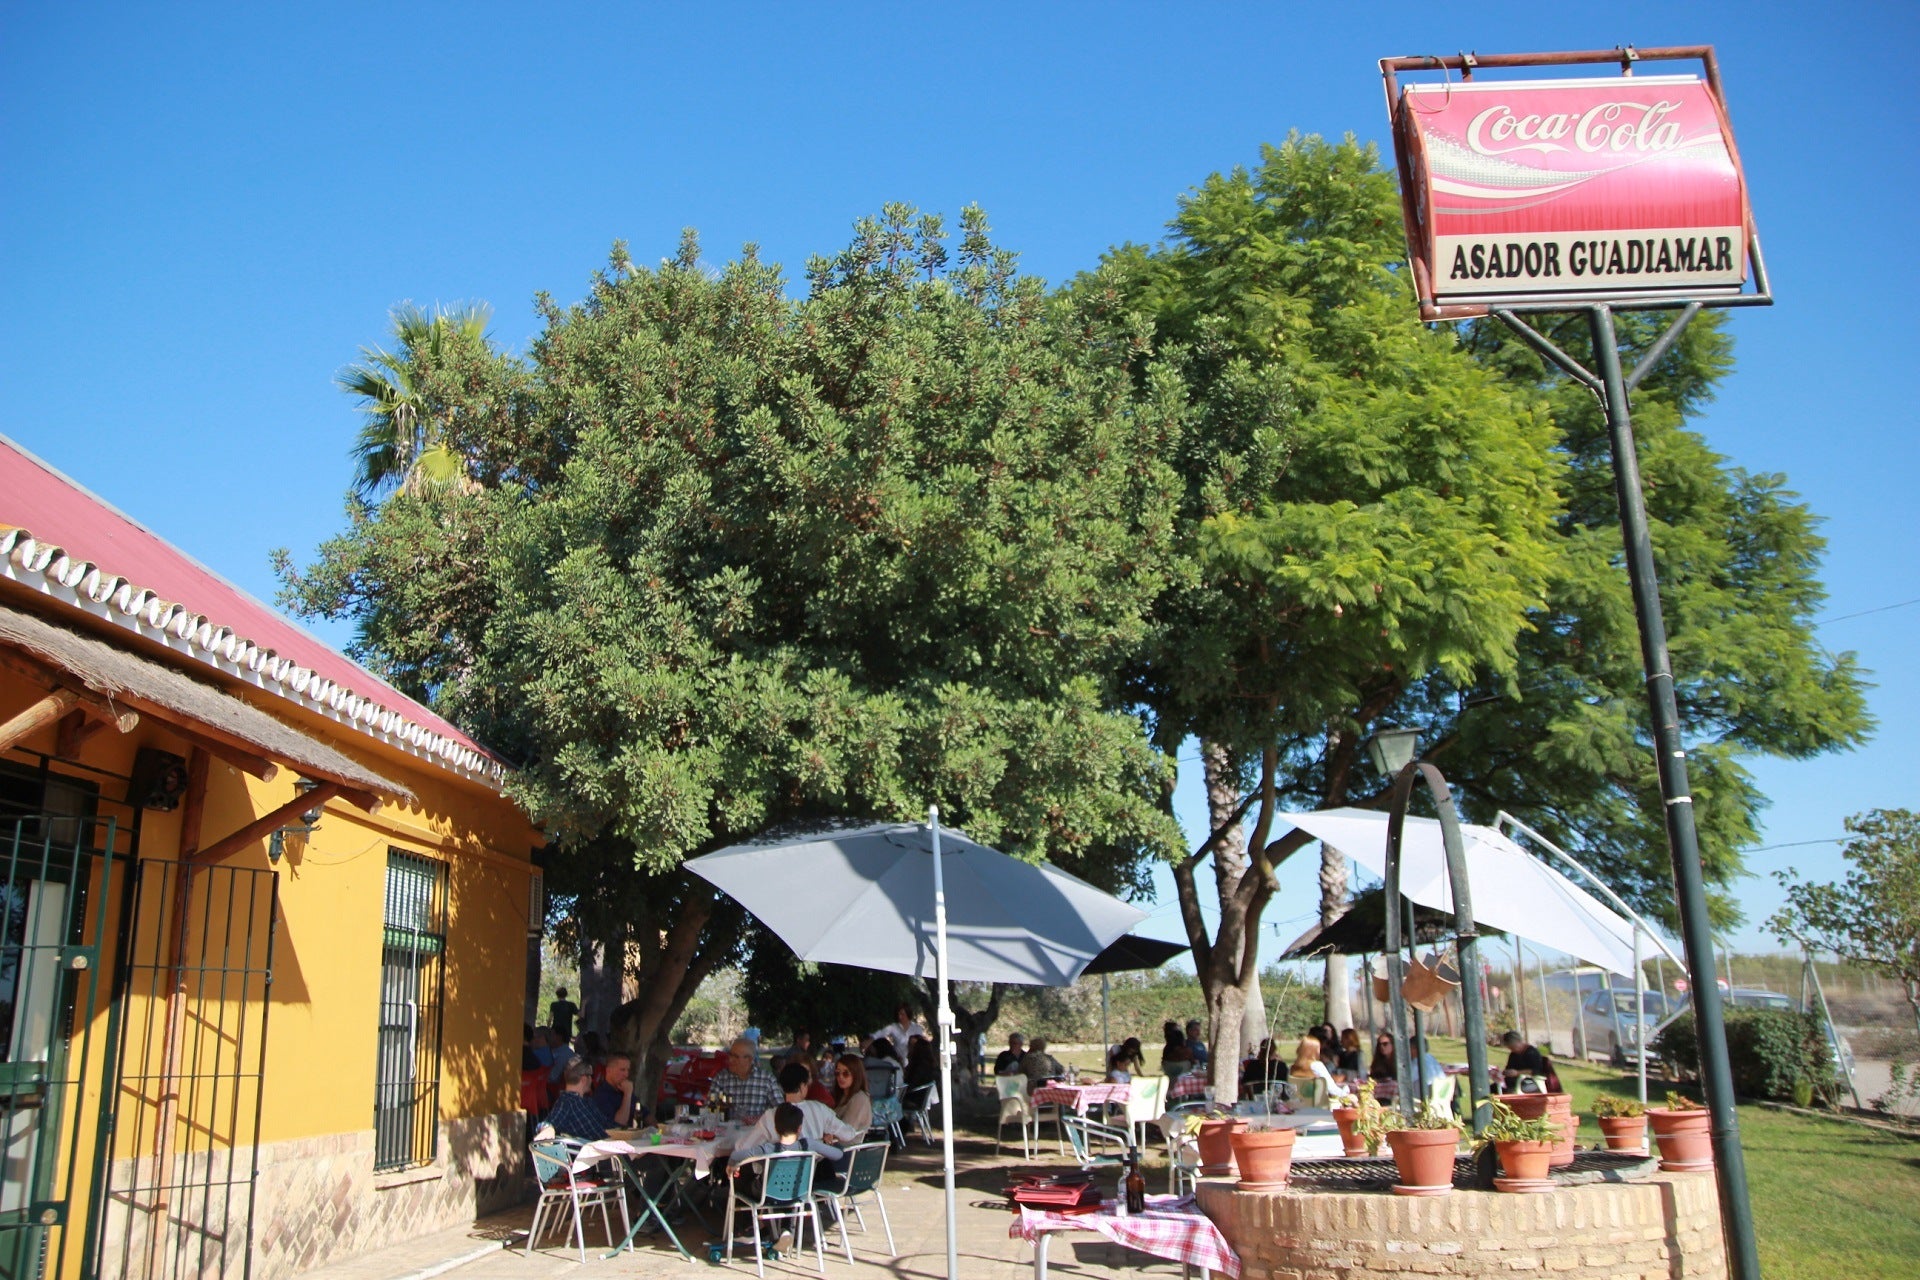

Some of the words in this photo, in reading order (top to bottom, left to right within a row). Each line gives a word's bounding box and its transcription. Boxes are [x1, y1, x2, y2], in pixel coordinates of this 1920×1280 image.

[1466, 100, 1684, 156] Coca-Cola
[1450, 242, 1561, 279] ASADOR
[1569, 236, 1733, 278] GUADIAMAR
